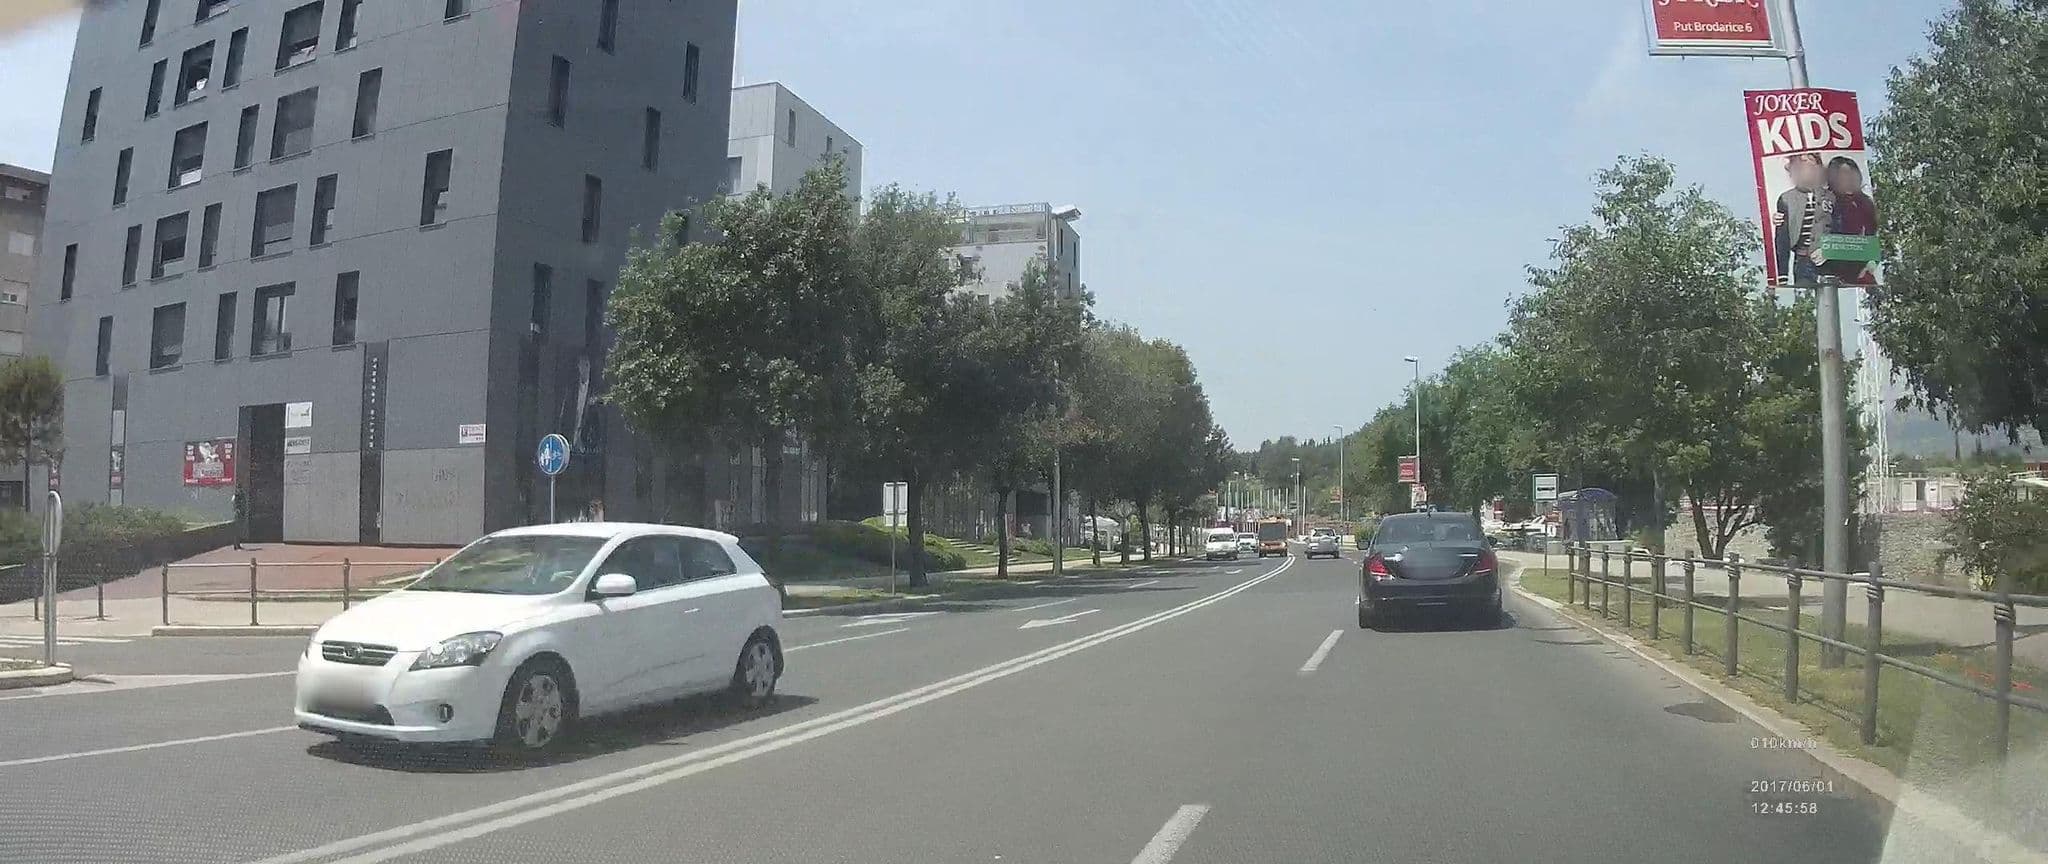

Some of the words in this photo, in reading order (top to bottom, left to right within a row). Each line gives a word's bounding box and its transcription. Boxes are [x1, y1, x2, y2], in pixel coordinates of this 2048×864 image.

[1673, 21, 1693, 31] Put
[1694, 21, 1744, 32] Brodarice
[1745, 23, 1753, 32] 6
[1753, 92, 1828, 115] JOKER
[1757, 112, 1852, 154] KIDS
